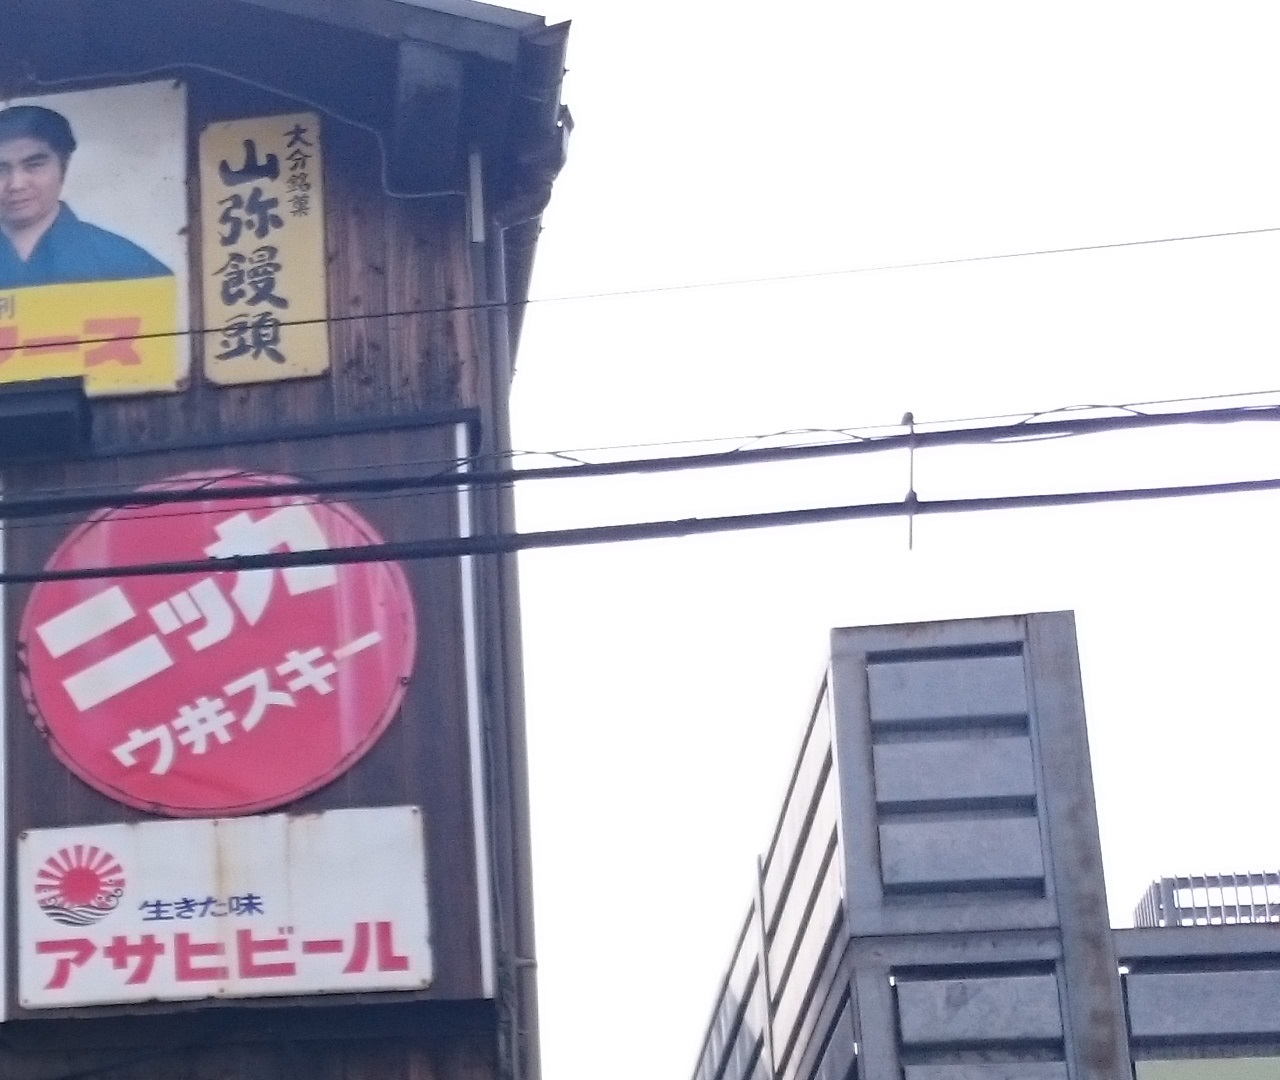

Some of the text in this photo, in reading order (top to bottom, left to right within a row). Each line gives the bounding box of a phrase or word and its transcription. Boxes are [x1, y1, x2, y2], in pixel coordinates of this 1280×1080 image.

[213, 138, 289, 366] 山弥饅頭
[35, 500, 339, 713] ニッカ
[35, 920, 410, 991] アサヒビール
[138, 892, 266, 922] 生きた味
